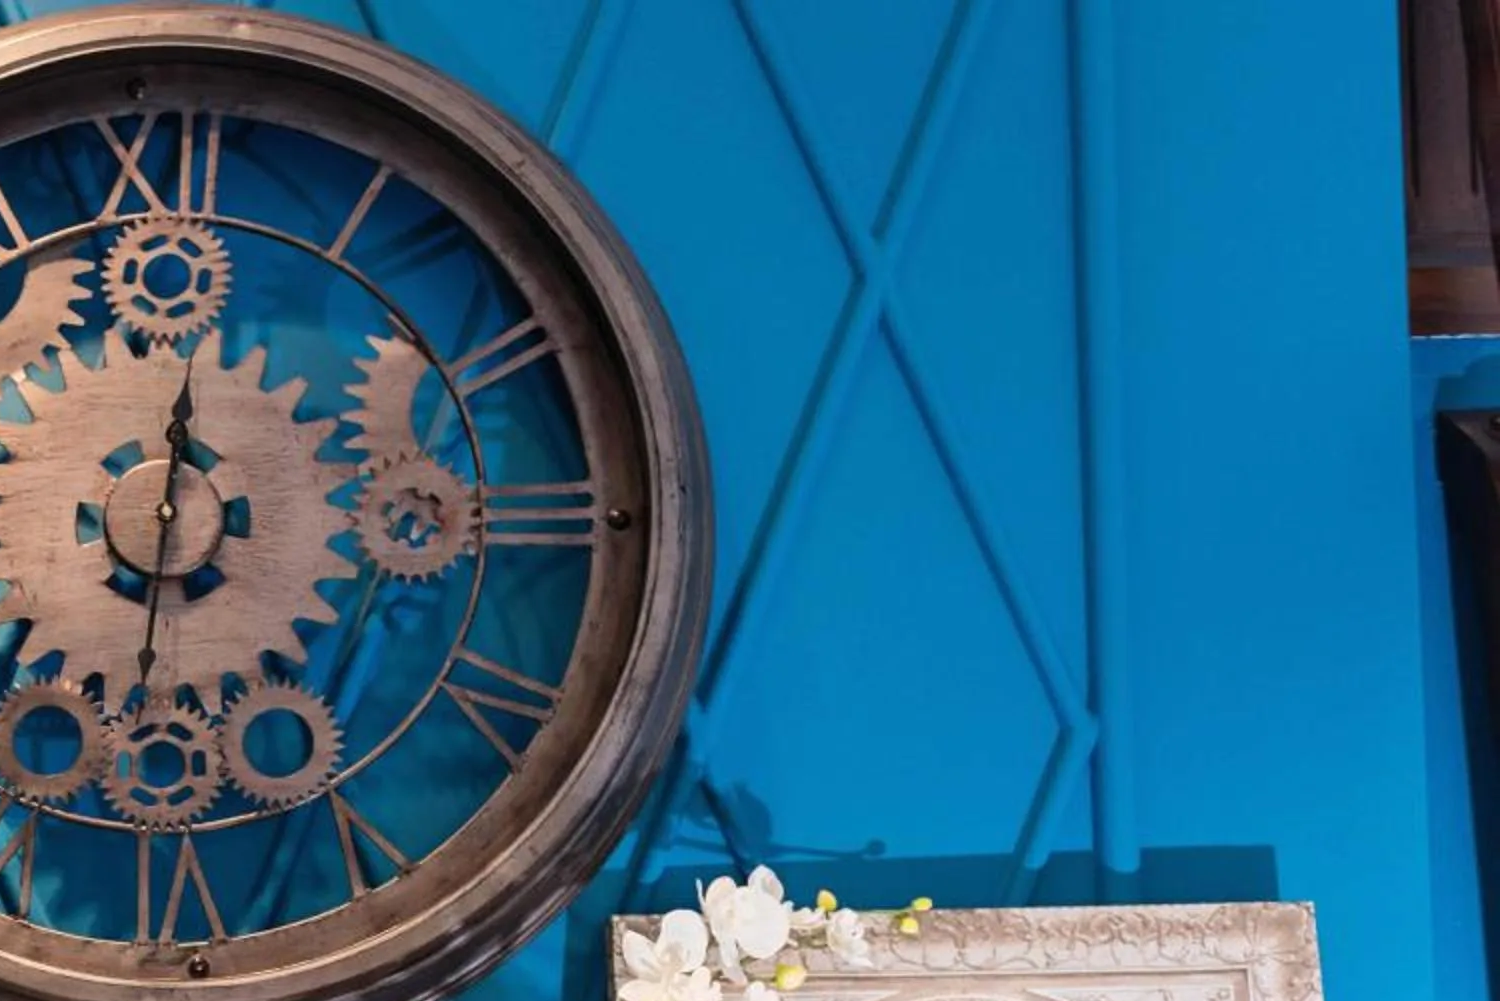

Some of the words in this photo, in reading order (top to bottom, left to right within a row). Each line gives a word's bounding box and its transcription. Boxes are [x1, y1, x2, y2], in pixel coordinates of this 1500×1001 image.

[94, 108, 222, 222] XII
[447, 318, 559, 398] II
[482, 482, 596, 546] III
[328, 785, 416, 898] V
